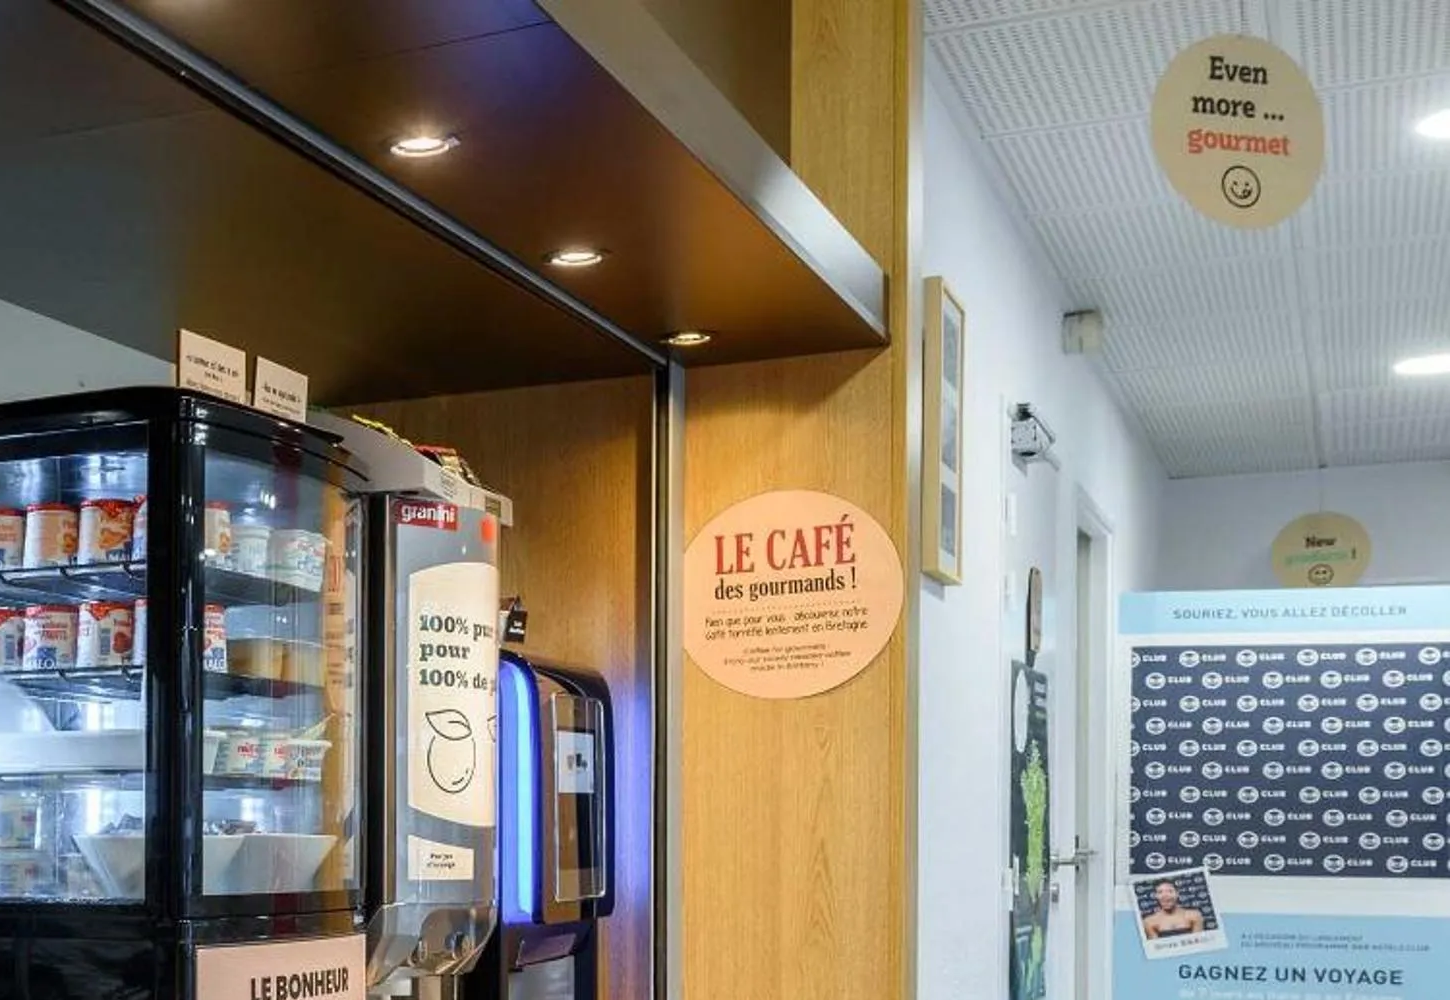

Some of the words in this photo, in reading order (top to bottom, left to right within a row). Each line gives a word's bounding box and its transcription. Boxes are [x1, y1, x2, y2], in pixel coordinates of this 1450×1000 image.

[1208, 55, 1269, 85] Even
[1191, 94, 1256, 119] more
[1186, 128, 1292, 157] gourmet
[400, 504, 456, 524] granini
[714, 531, 755, 576] LE
[766, 513, 856, 571] CAFÉ
[714, 575, 744, 602] des
[749, 568, 846, 602] gourmands
[851, 566, 857, 590] !
[744, 615, 763, 628] pour
[1241, 608, 1279, 619] VOUS
[1282, 606, 1327, 618] ALLEZ
[1330, 604, 1407, 617] DÉCOLLER
[418, 614, 470, 636] 100%
[418, 641, 471, 662] pour
[418, 667, 469, 689] 100%
[472, 671, 488, 690] de
[1178, 964, 1267, 982] GAGNEZ
[1275, 967, 1307, 983] UN
[1314, 968, 1405, 986] VOYAGE
